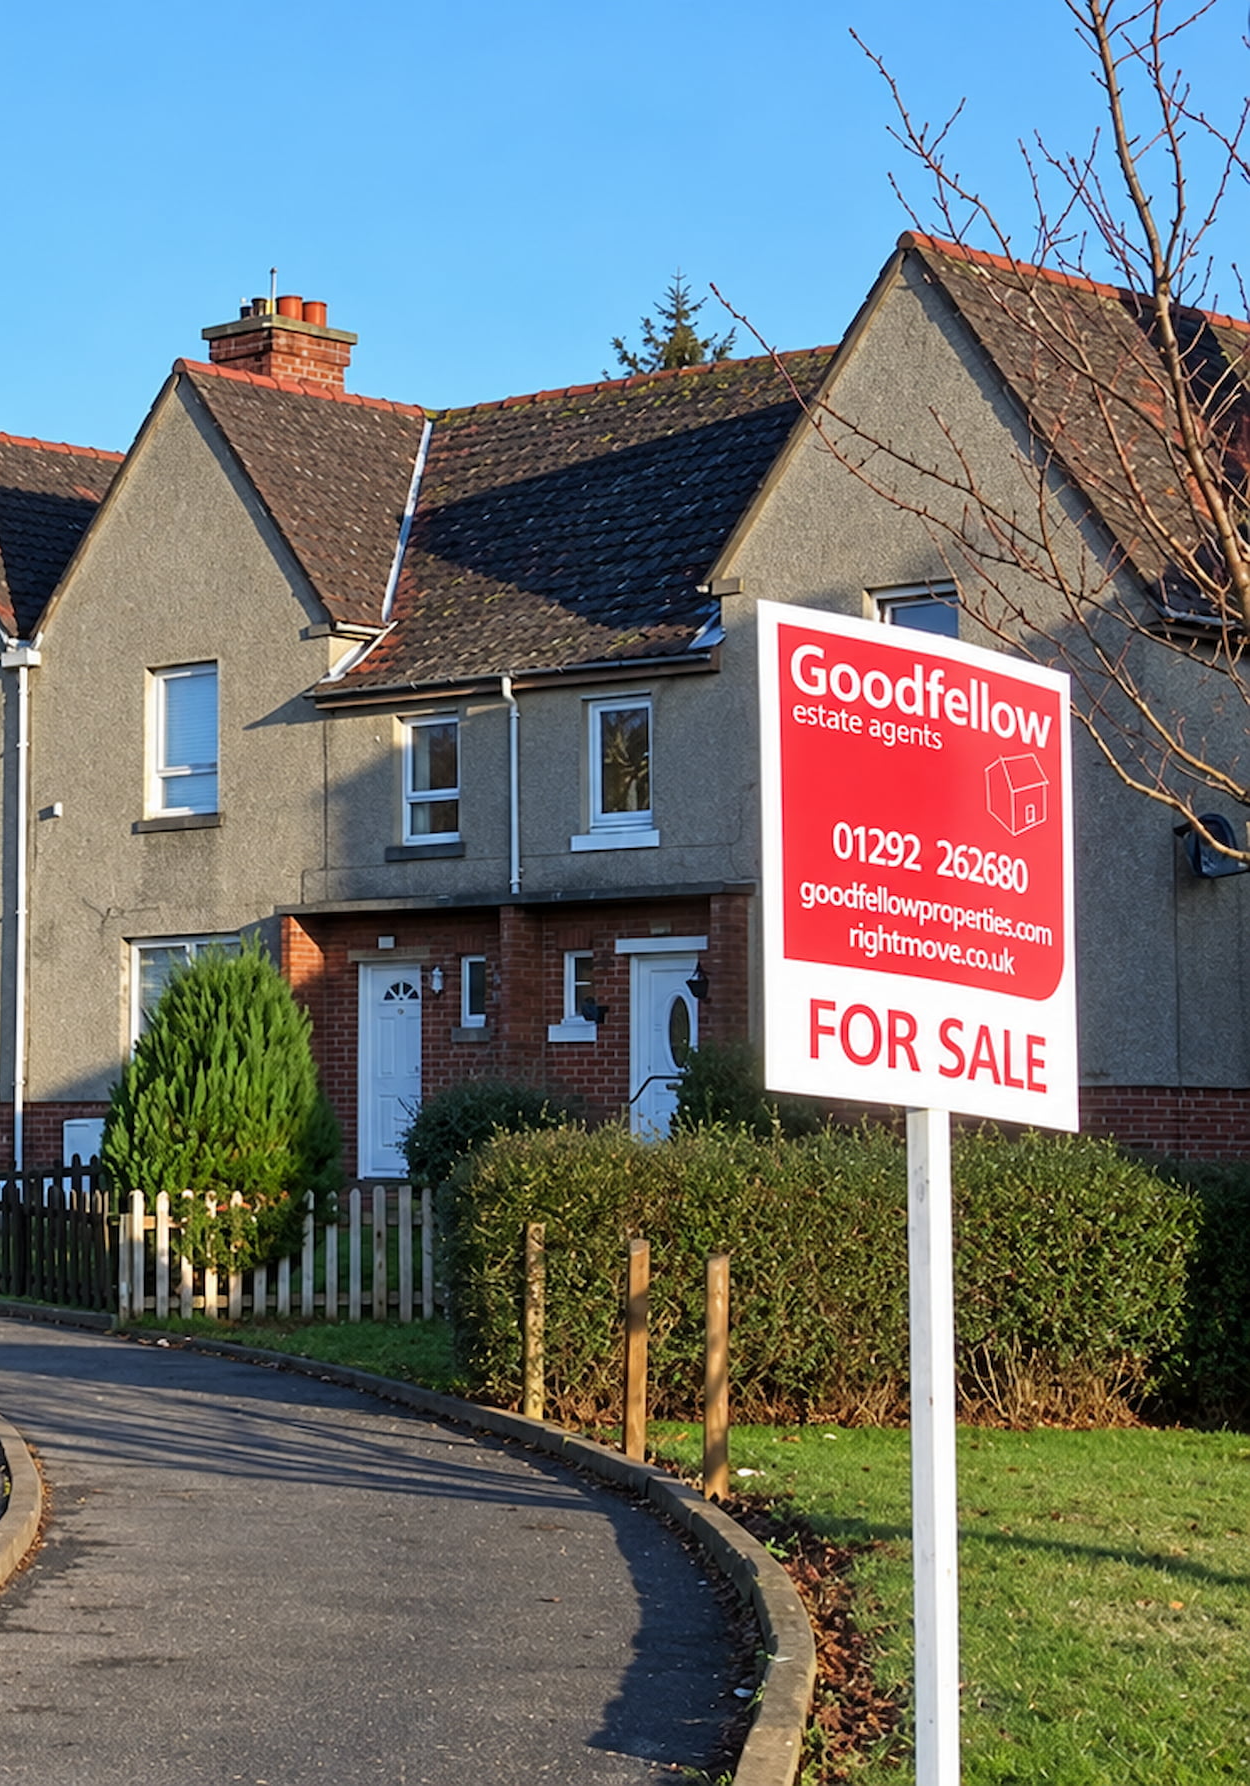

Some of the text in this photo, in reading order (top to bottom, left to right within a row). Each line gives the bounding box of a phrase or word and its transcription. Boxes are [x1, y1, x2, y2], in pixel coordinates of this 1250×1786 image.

[790, 644, 1052, 749] Goodfellow
[792, 704, 943, 750] estate agents
[833, 821, 1029, 894] 01292 262680
[800, 880, 1053, 947] goodfellowproperties.com
[849, 923, 1015, 976] rightmove.co.uk
[809, 997, 1047, 1094] FOR SALE
